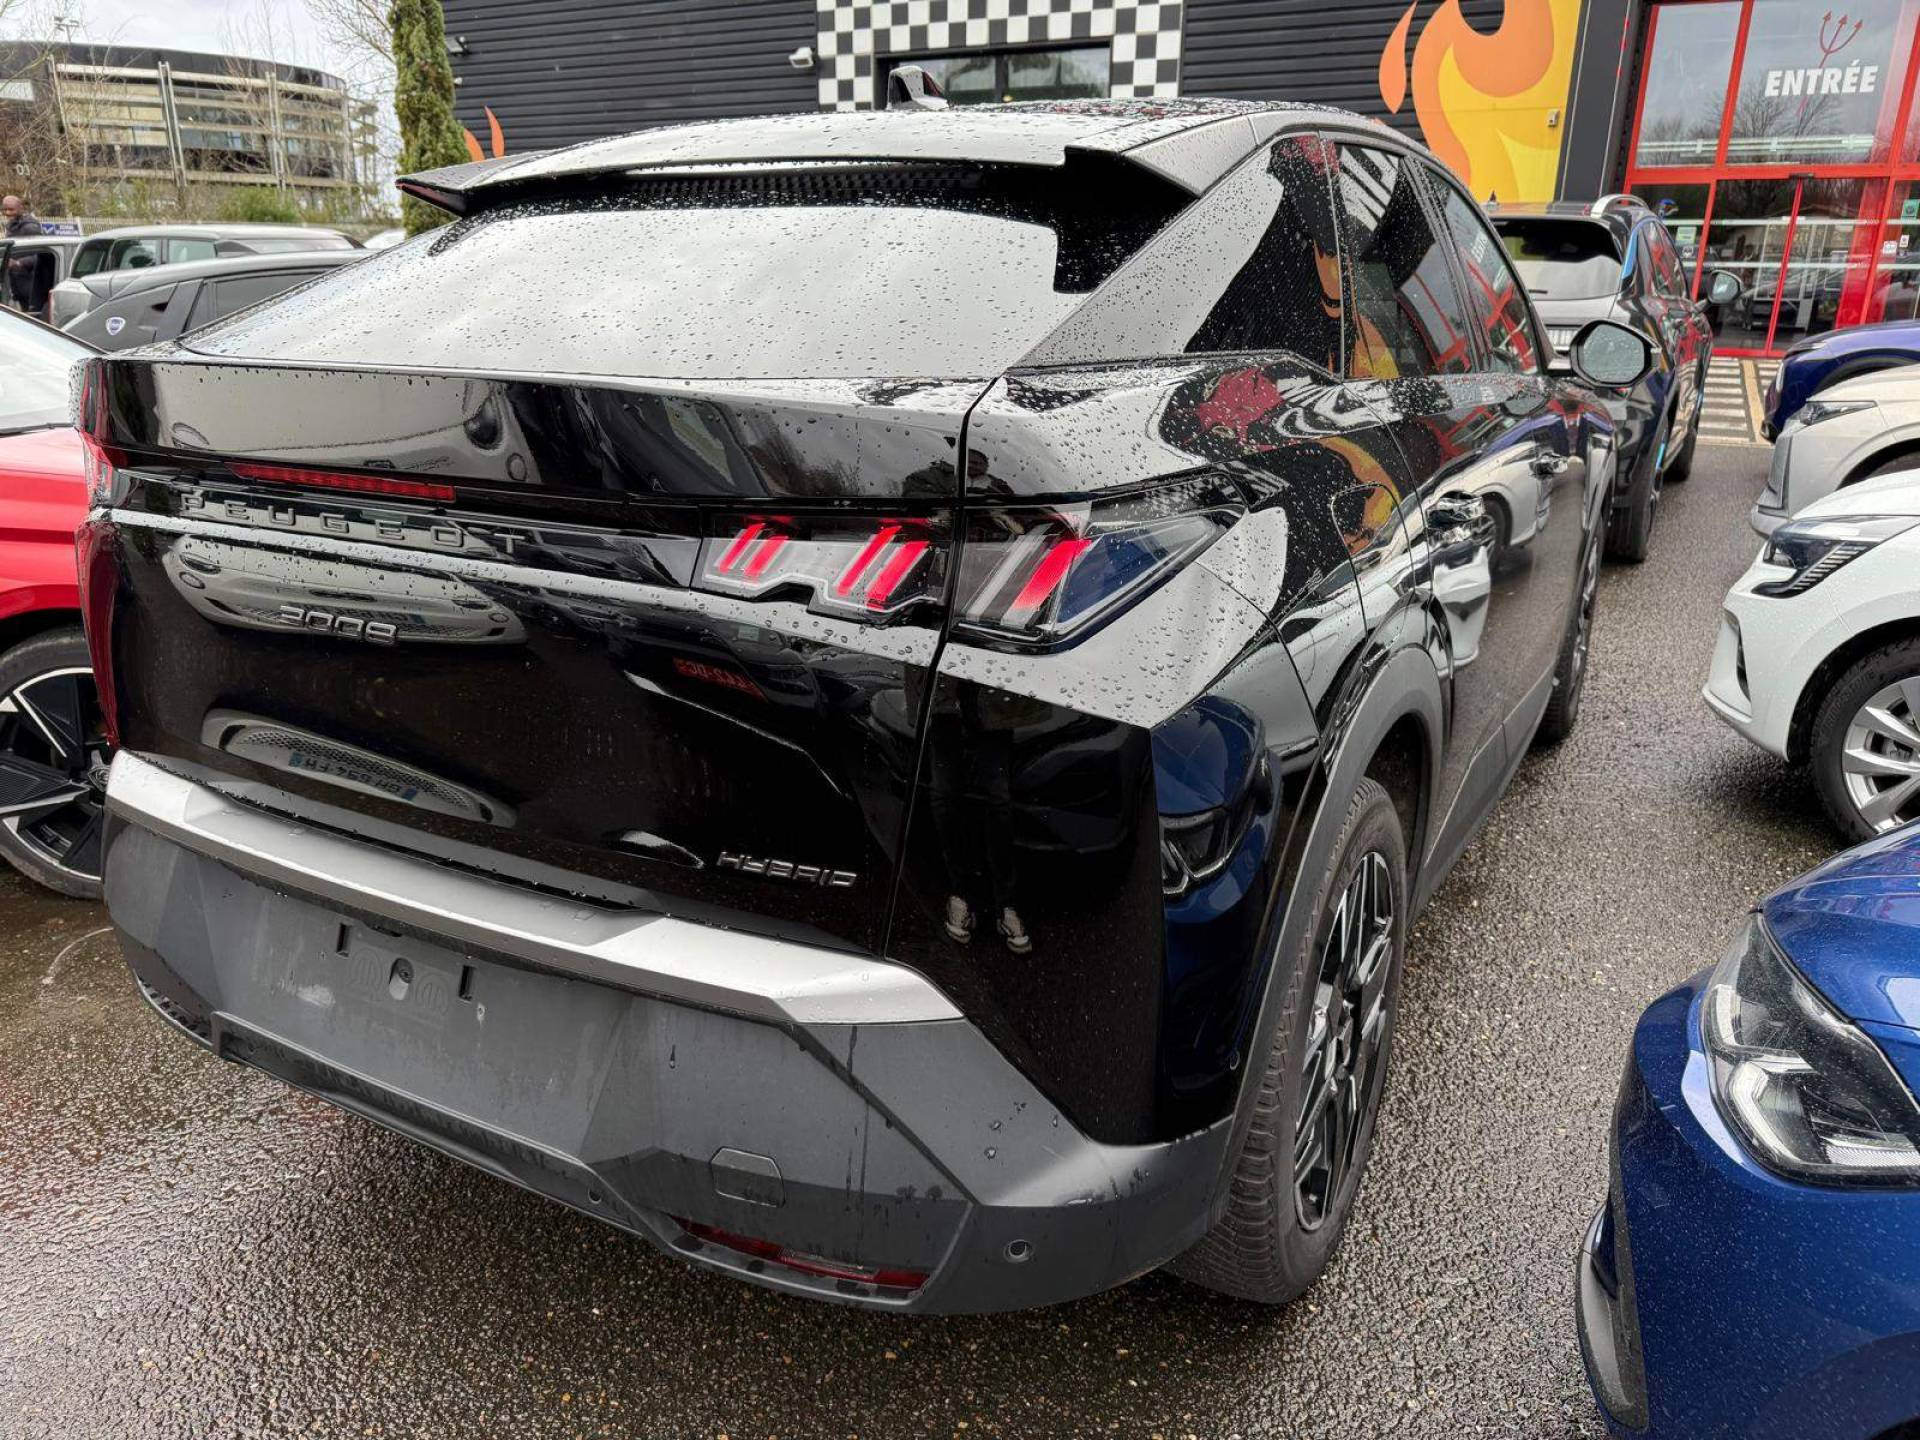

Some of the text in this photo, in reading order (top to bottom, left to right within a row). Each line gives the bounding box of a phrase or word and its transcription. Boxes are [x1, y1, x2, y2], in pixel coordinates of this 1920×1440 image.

[1764, 59, 1879, 98] ENTRÉE
[180, 492, 526, 554] PEUGEOT
[280, 605, 397, 645] 3008
[716, 851, 857, 887] HYBRID
